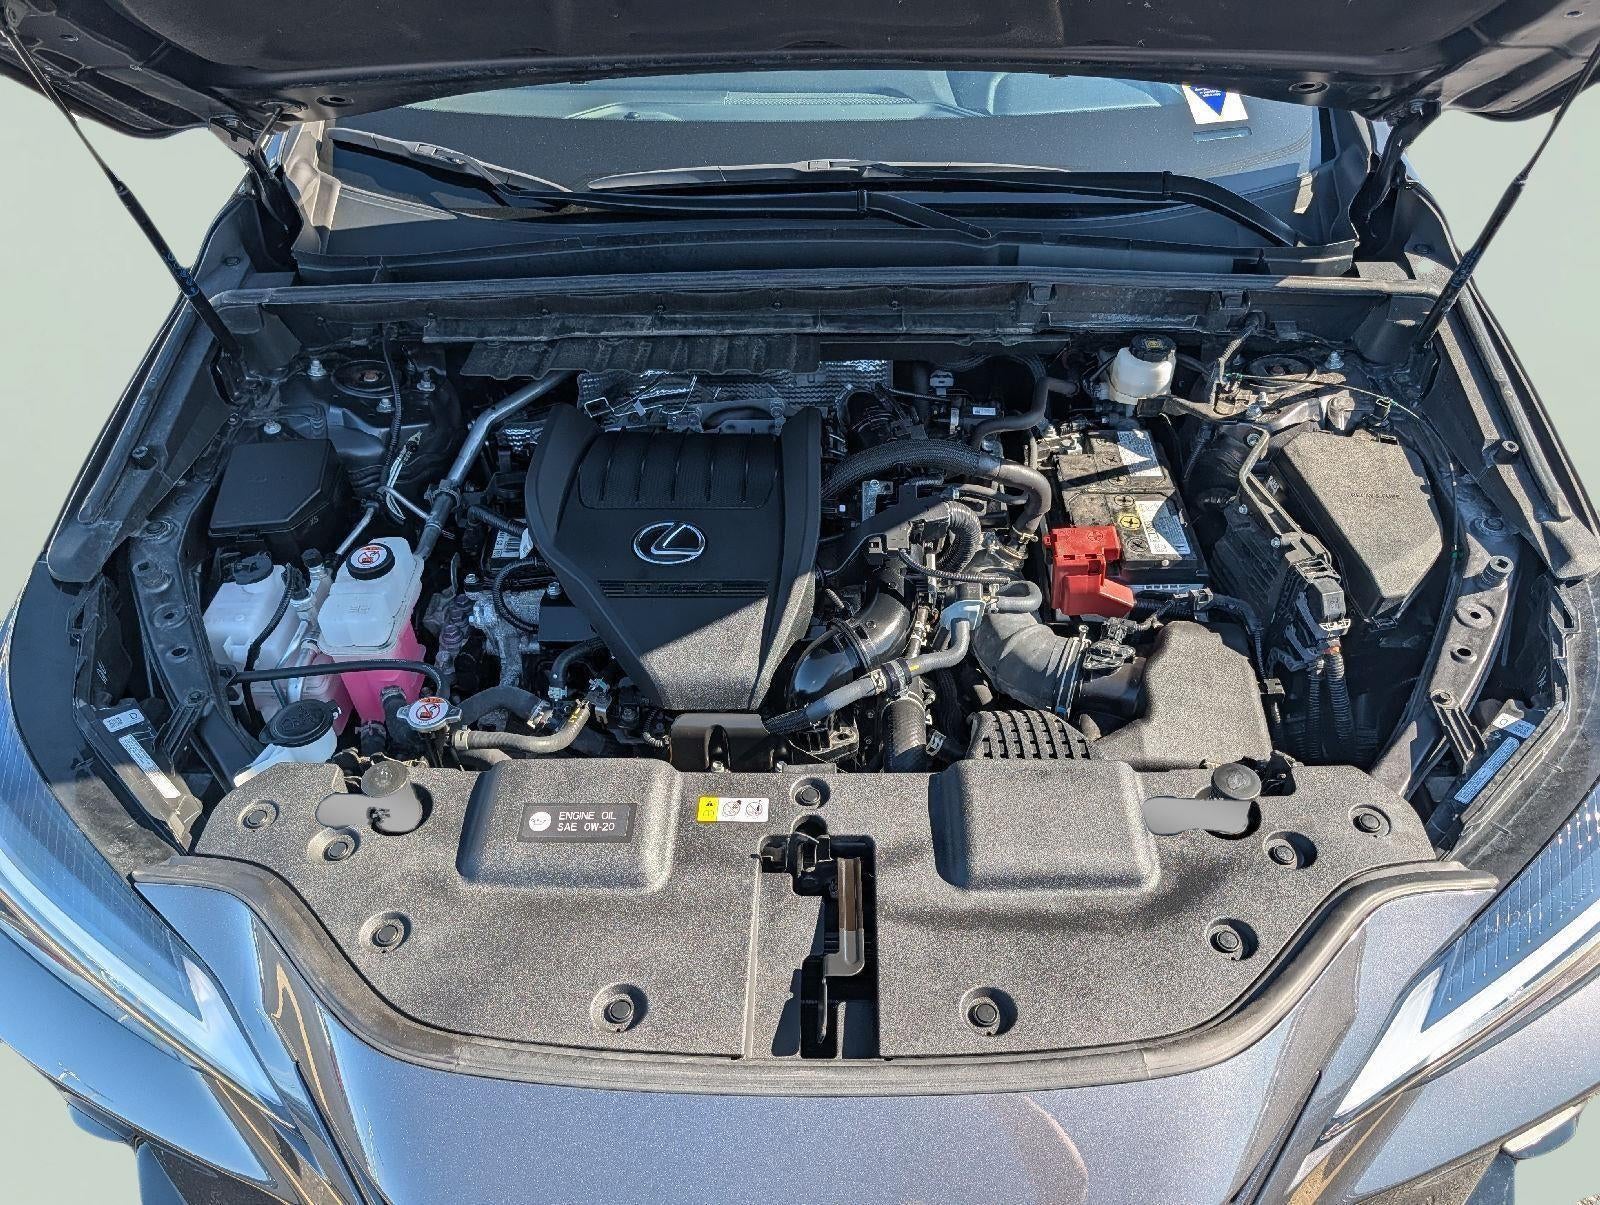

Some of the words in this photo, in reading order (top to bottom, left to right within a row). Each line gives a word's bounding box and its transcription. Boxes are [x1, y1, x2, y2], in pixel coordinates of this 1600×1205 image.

[559, 811, 595, 820] ENGINE
[602, 811, 616, 820] OIL
[557, 822, 577, 831] SAE
[584, 822, 615, 831] 0W-20
